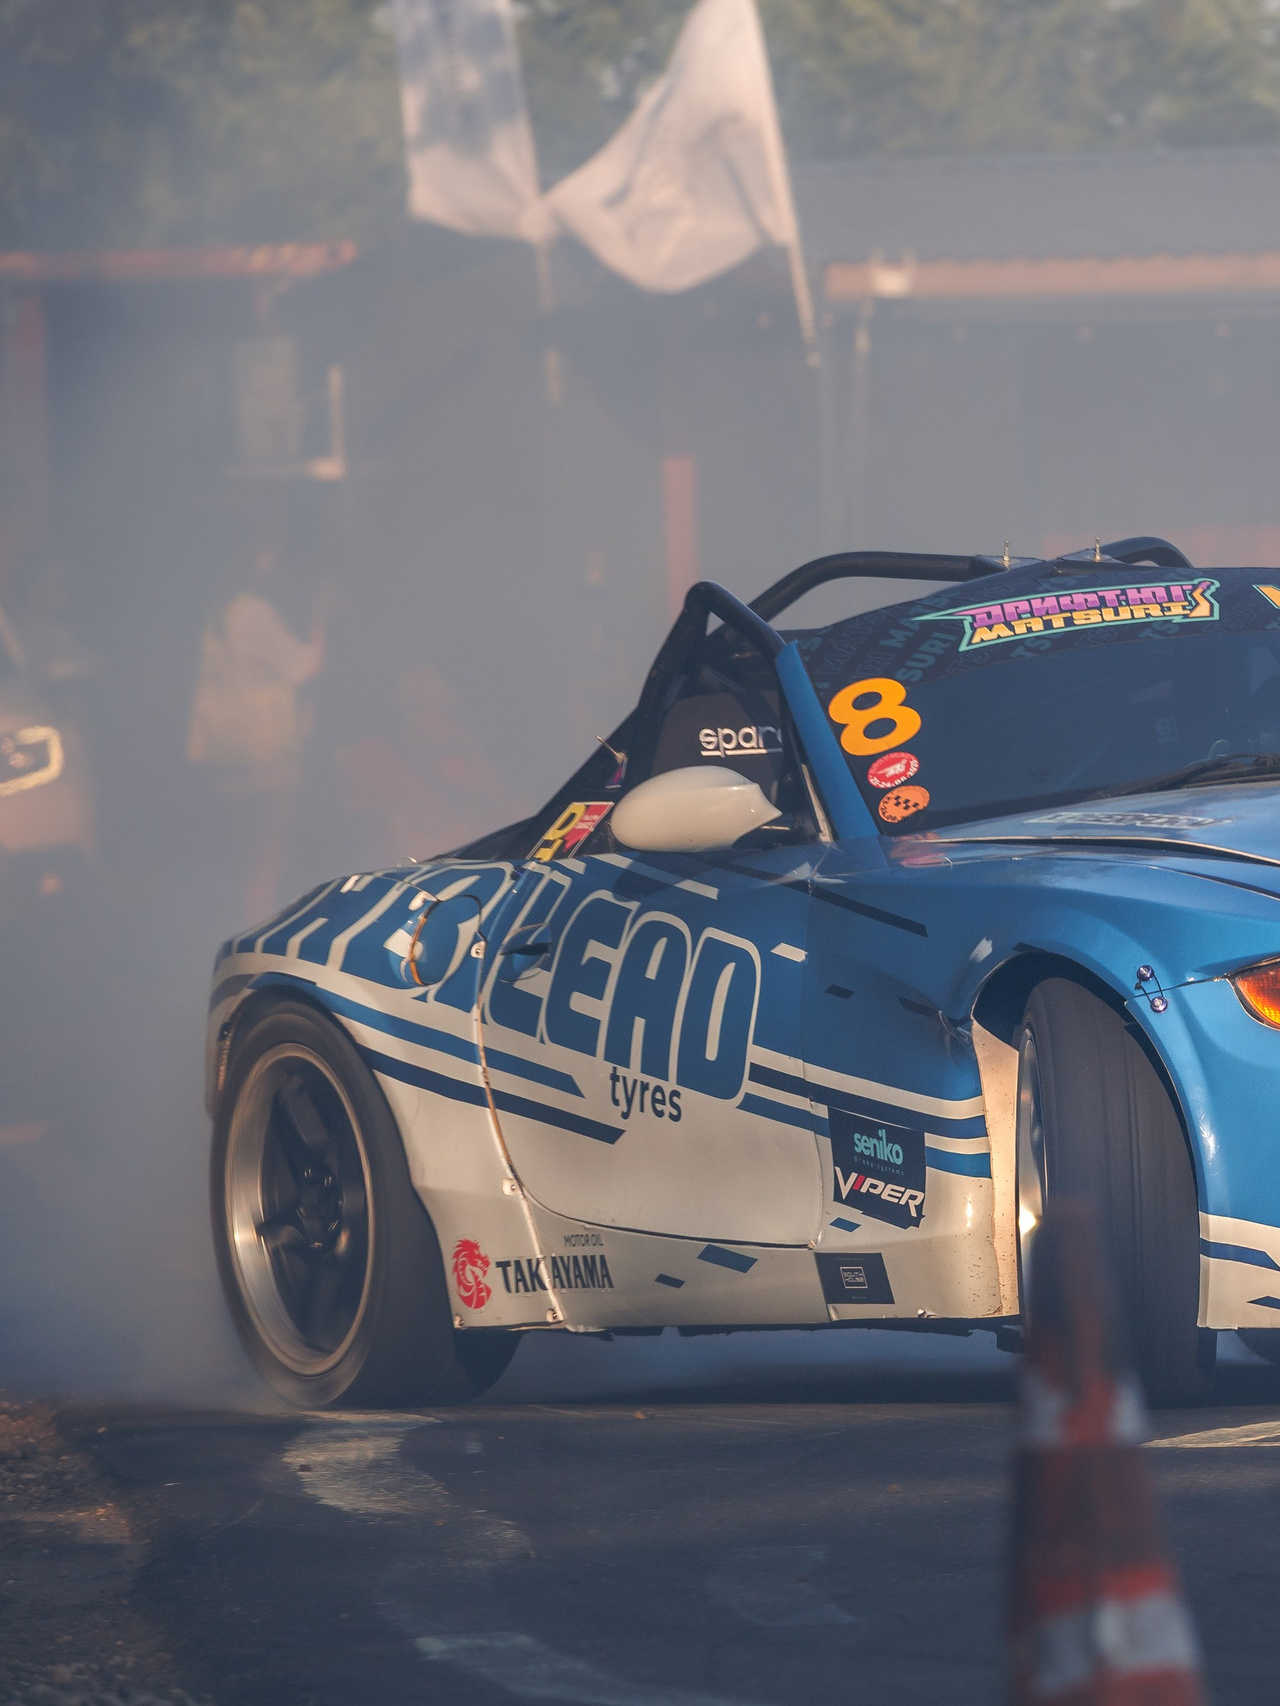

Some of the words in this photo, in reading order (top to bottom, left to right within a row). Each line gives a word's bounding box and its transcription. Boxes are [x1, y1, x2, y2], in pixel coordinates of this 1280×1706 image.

[971, 601, 1191, 644] MATSURI
[828, 678, 921, 757] 8
[699, 725, 782, 758] spar
[610, 1066, 682, 1123] tyres
[854, 1129, 904, 1165] seniko
[835, 1166, 925, 1218] VIPER
[563, 1234, 590, 1247] MOTOR
[591, 1234, 604, 1247] OIL
[495, 1254, 614, 1294] TAKAYAMA
